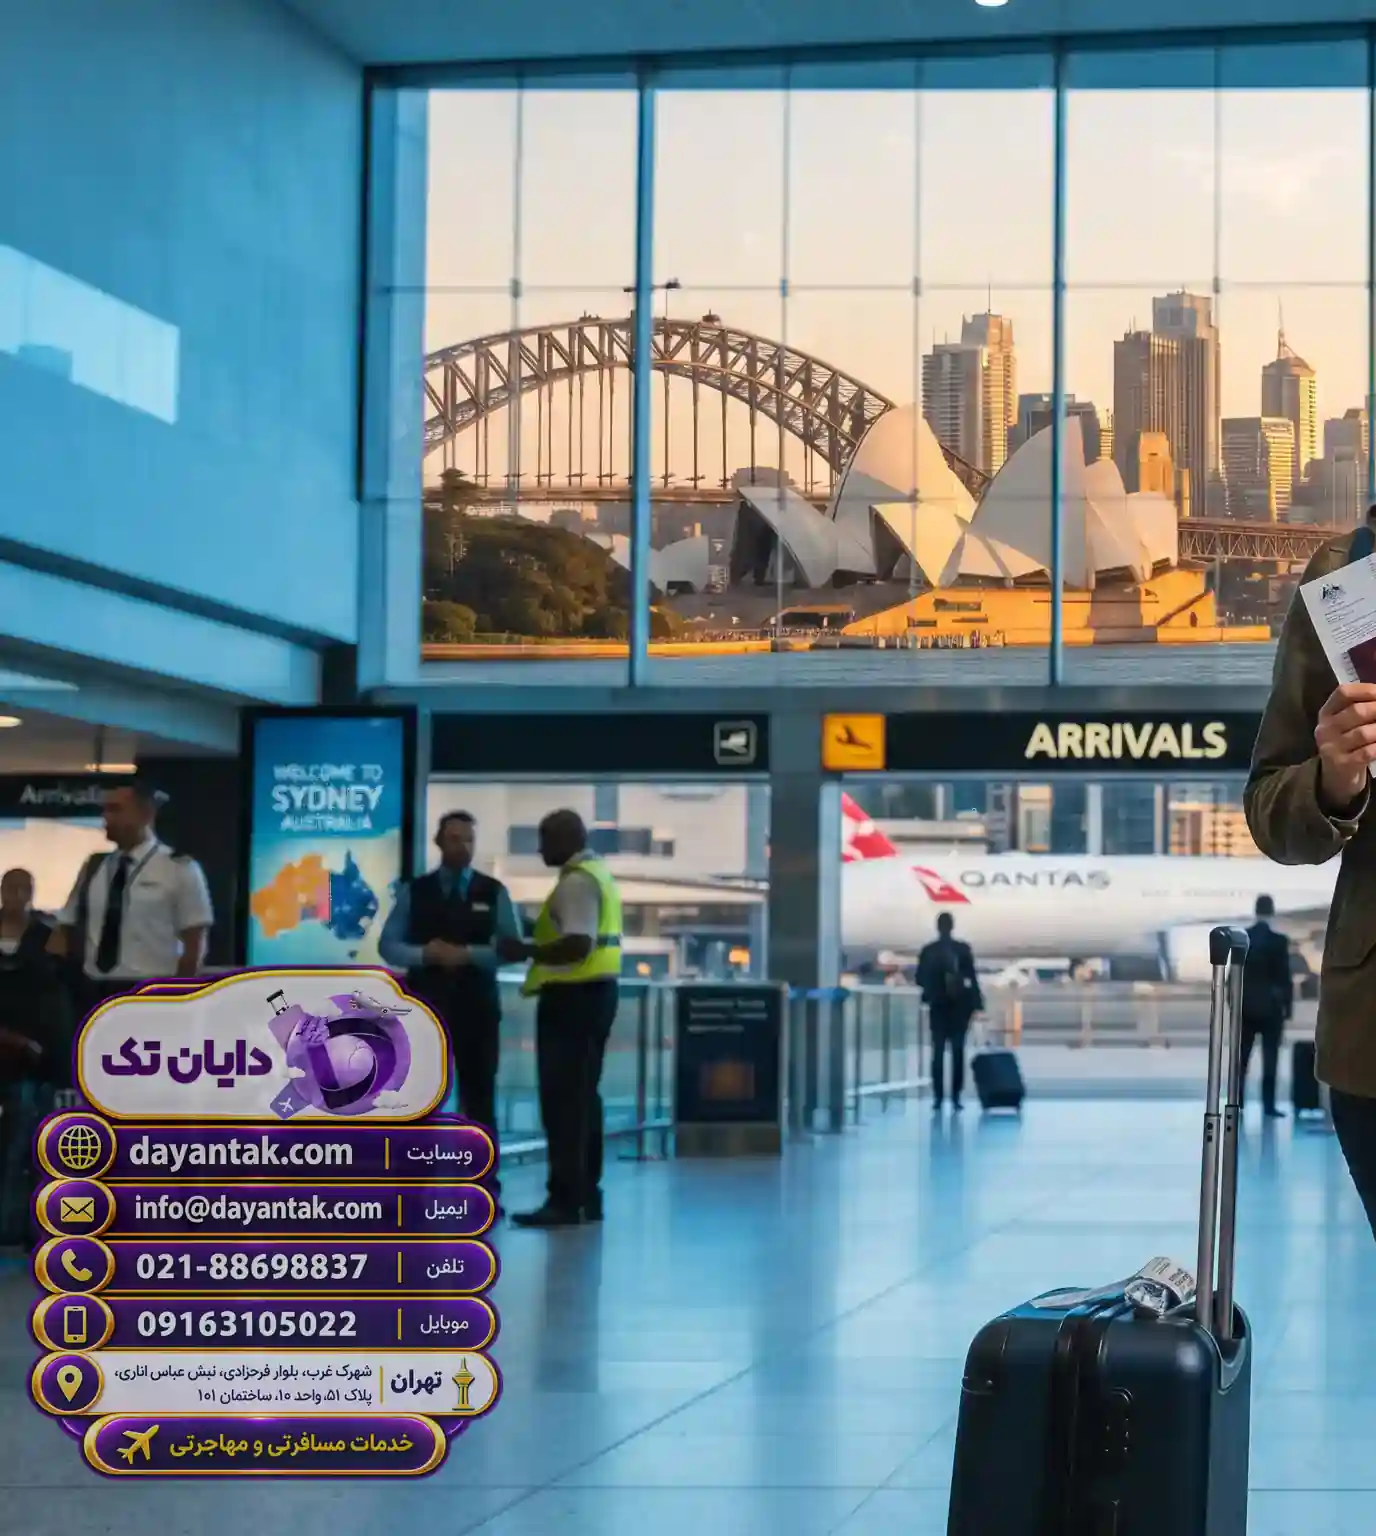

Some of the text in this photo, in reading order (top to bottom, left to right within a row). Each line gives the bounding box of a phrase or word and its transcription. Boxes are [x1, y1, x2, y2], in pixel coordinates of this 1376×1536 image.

[1024, 722, 1228, 759] ARRIVALS
[273, 763, 384, 782] WELCOME TO
[19, 783, 102, 806] Arrival
[272, 784, 384, 812] SYDNEY
[280, 814, 372, 831] AUSTRALIA
[960, 869, 1111, 890] QANTAS
